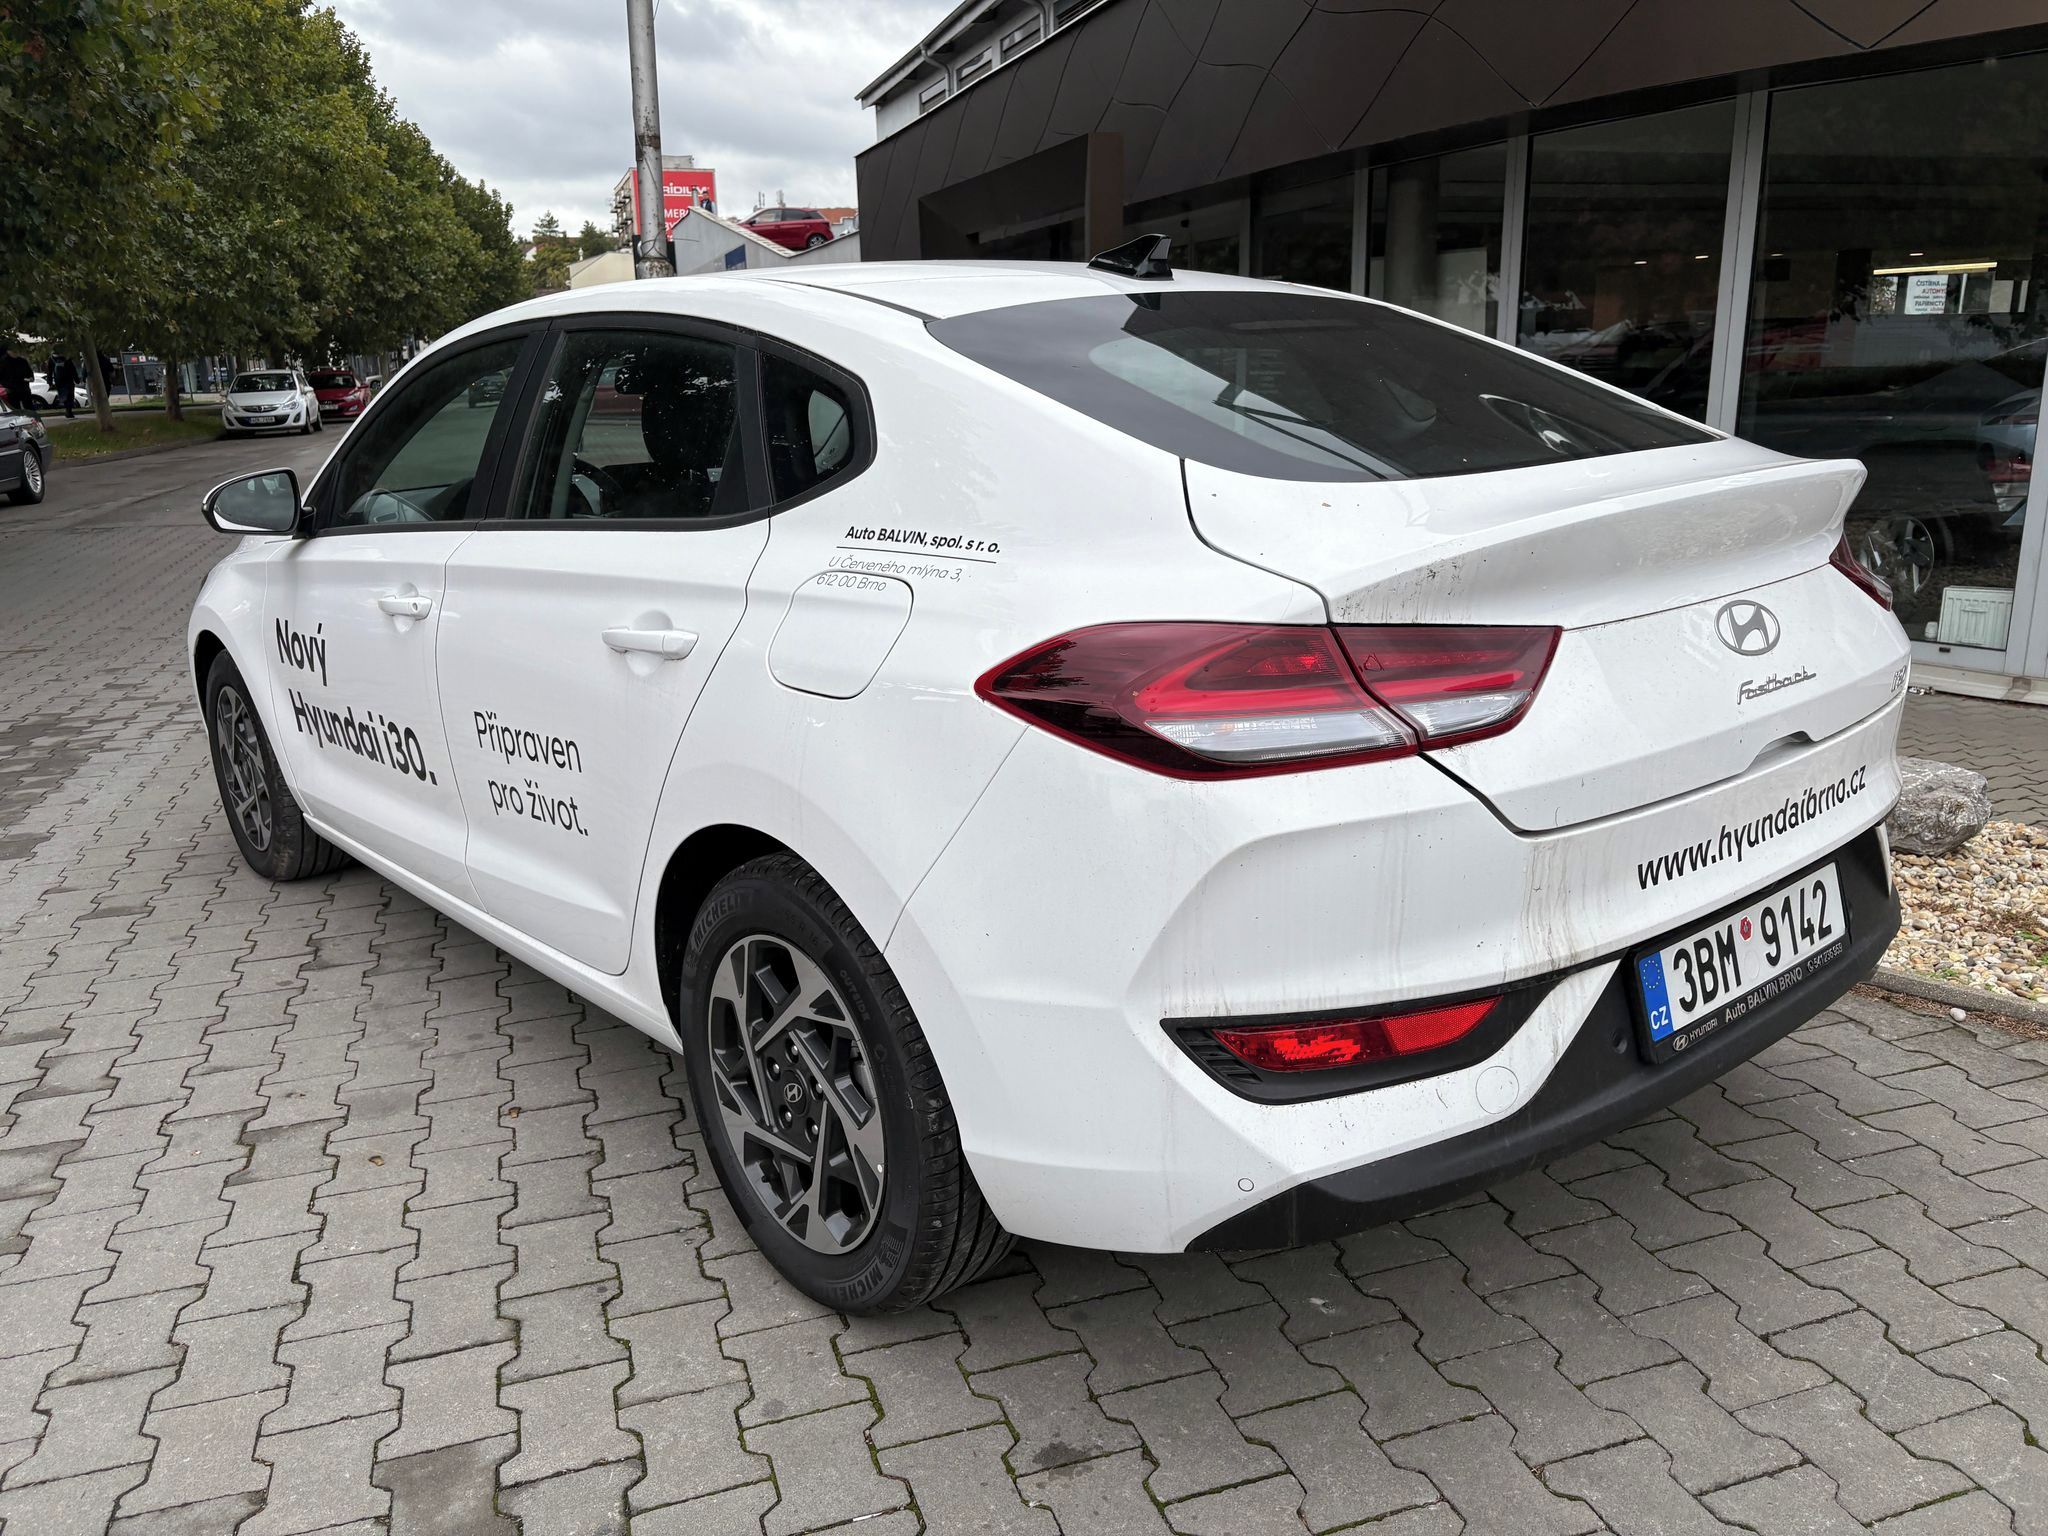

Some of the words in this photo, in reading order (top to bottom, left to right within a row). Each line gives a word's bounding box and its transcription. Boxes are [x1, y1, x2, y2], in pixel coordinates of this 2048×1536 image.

[828, 556, 840, 567] U
[841, 554, 909, 574] Červeného
[910, 564, 949, 579] mlýna
[950, 568, 962, 583] 3,
[845, 526, 876, 541] Auto
[877, 528, 927, 548] BALVIN,
[929, 535, 963, 550] spol.
[965, 540, 974, 550] s
[975, 541, 984, 551] r.
[987, 542, 1001, 553] o.
[816, 573, 834, 587] 612
[838, 575, 857, 588] 00
[857, 577, 887, 592] Brno
[275, 617, 328, 687] Nový
[1737, 665, 1817, 705] Fastback
[288, 688, 385, 765] Hyundai
[378, 714, 438, 786] i30.
[474, 709, 583, 773] Připraven
[487, 779, 524, 815] pro
[524, 777, 589, 837] život.
[1637, 764, 1867, 890] www.hyundaibrno.cz
[1673, 923, 1742, 1013] 3BM
[1760, 879, 1833, 967] 9142
[1650, 1006, 1669, 1031] CZ
[1688, 1017, 1718, 1041] HYUNDAI
[1725, 1003, 1747, 1023] Auto
[1747, 983, 1779, 1009] BALVIN
[1779, 966, 1803, 990] BRNO
